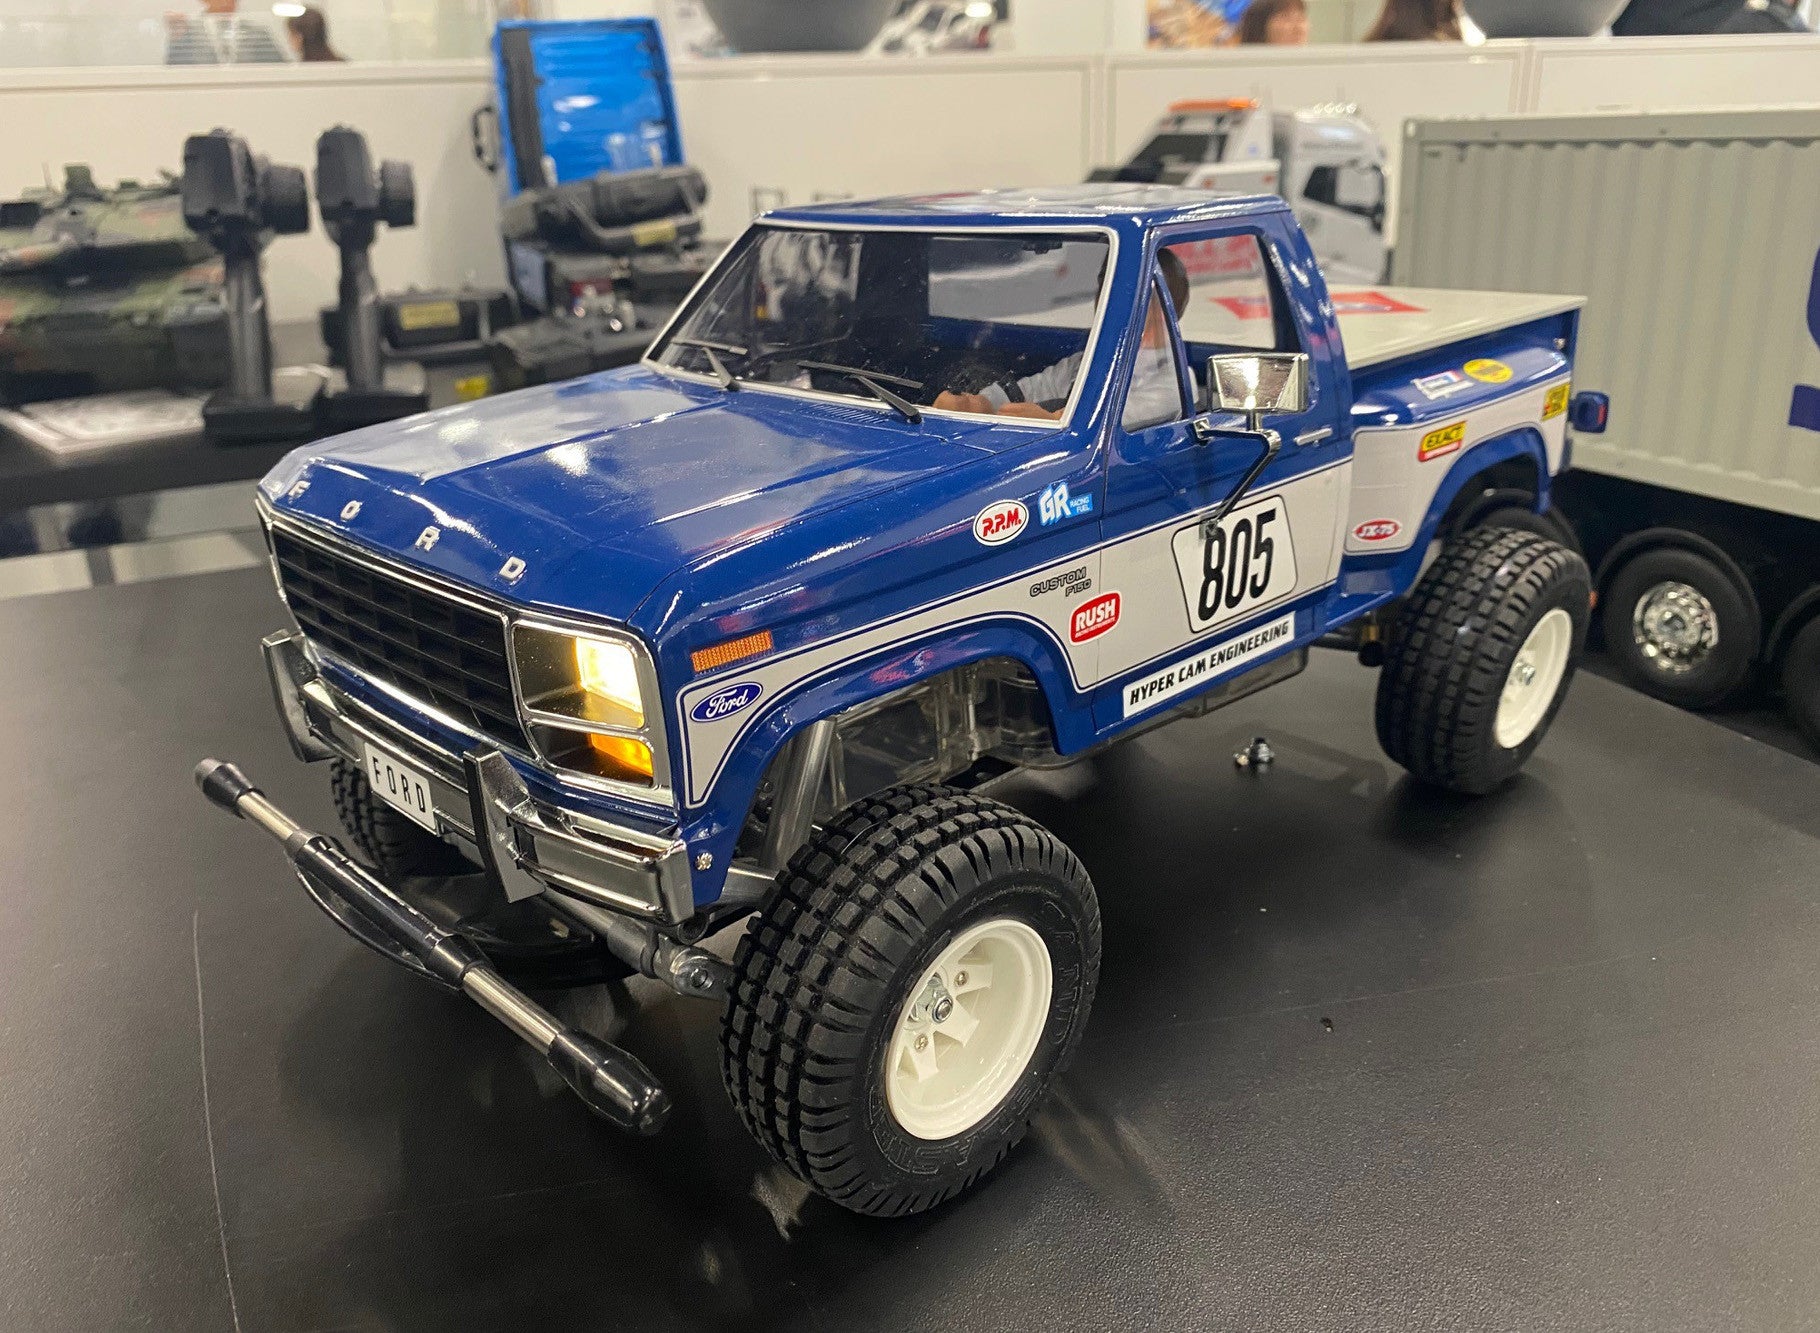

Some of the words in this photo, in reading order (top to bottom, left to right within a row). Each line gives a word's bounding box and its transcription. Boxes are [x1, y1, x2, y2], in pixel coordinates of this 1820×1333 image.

[1039, 483, 1072, 525] GR
[1030, 566, 1087, 598] CUSTOM
[1198, 507, 1276, 621] 805
[1065, 578, 1092, 597] F150
[1075, 598, 1117, 633] RUSH
[1129, 672, 1175, 706] HYPER
[1178, 659, 1206, 683] CAM
[1209, 620, 1289, 669] ENGINEERING
[705, 688, 749, 718] Ford
[372, 756, 426, 814] FORD
